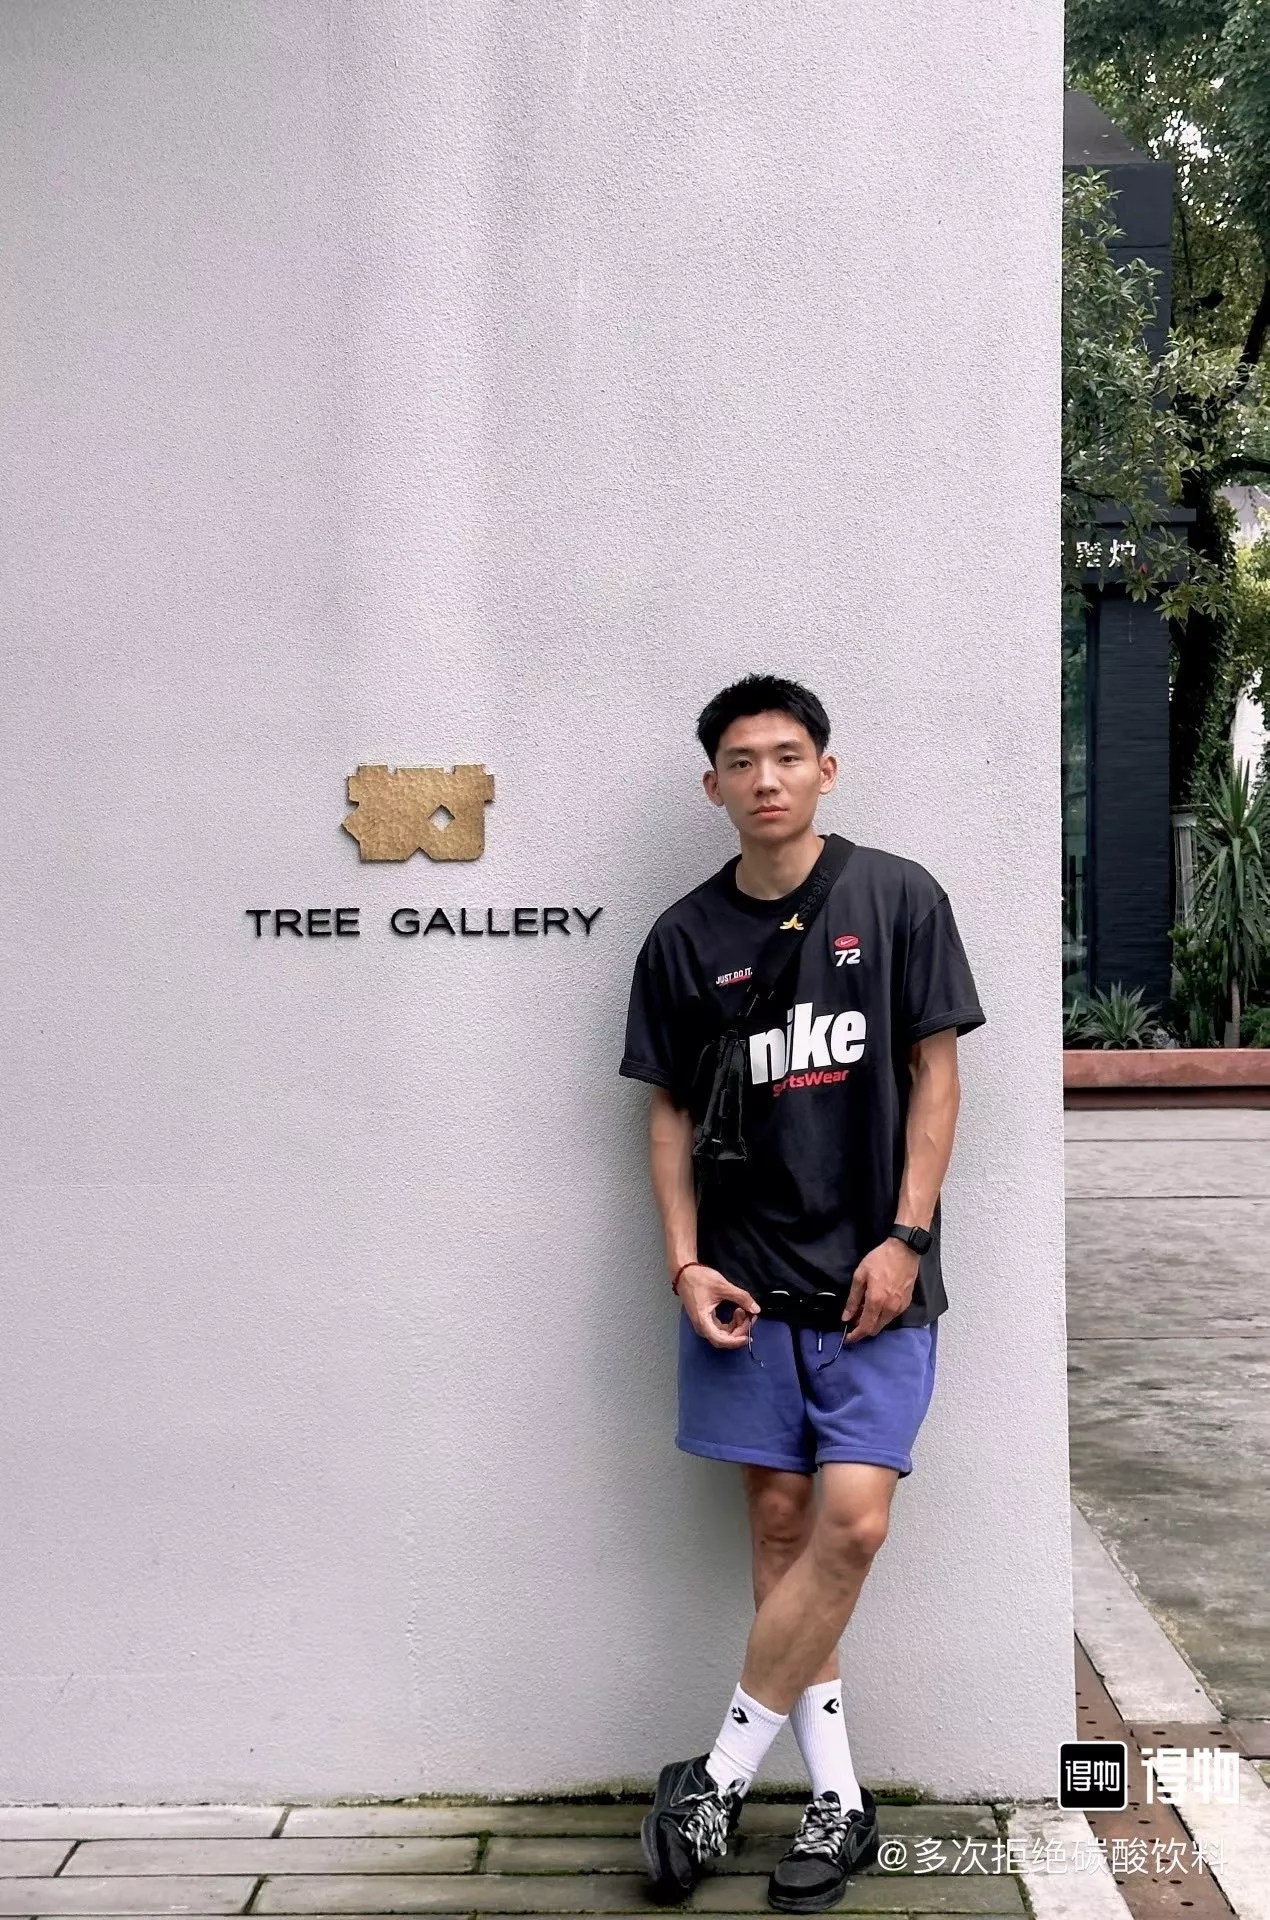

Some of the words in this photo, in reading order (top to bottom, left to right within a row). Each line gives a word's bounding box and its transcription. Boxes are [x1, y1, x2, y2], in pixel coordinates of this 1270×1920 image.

[246, 908, 361, 937] TREE
[391, 907, 604, 937] GALLERY
[835, 948, 861, 967] 72
[715, 972, 733, 985] JUST
[733, 969, 744, 979] DO
[749, 1002, 867, 1085] nike
